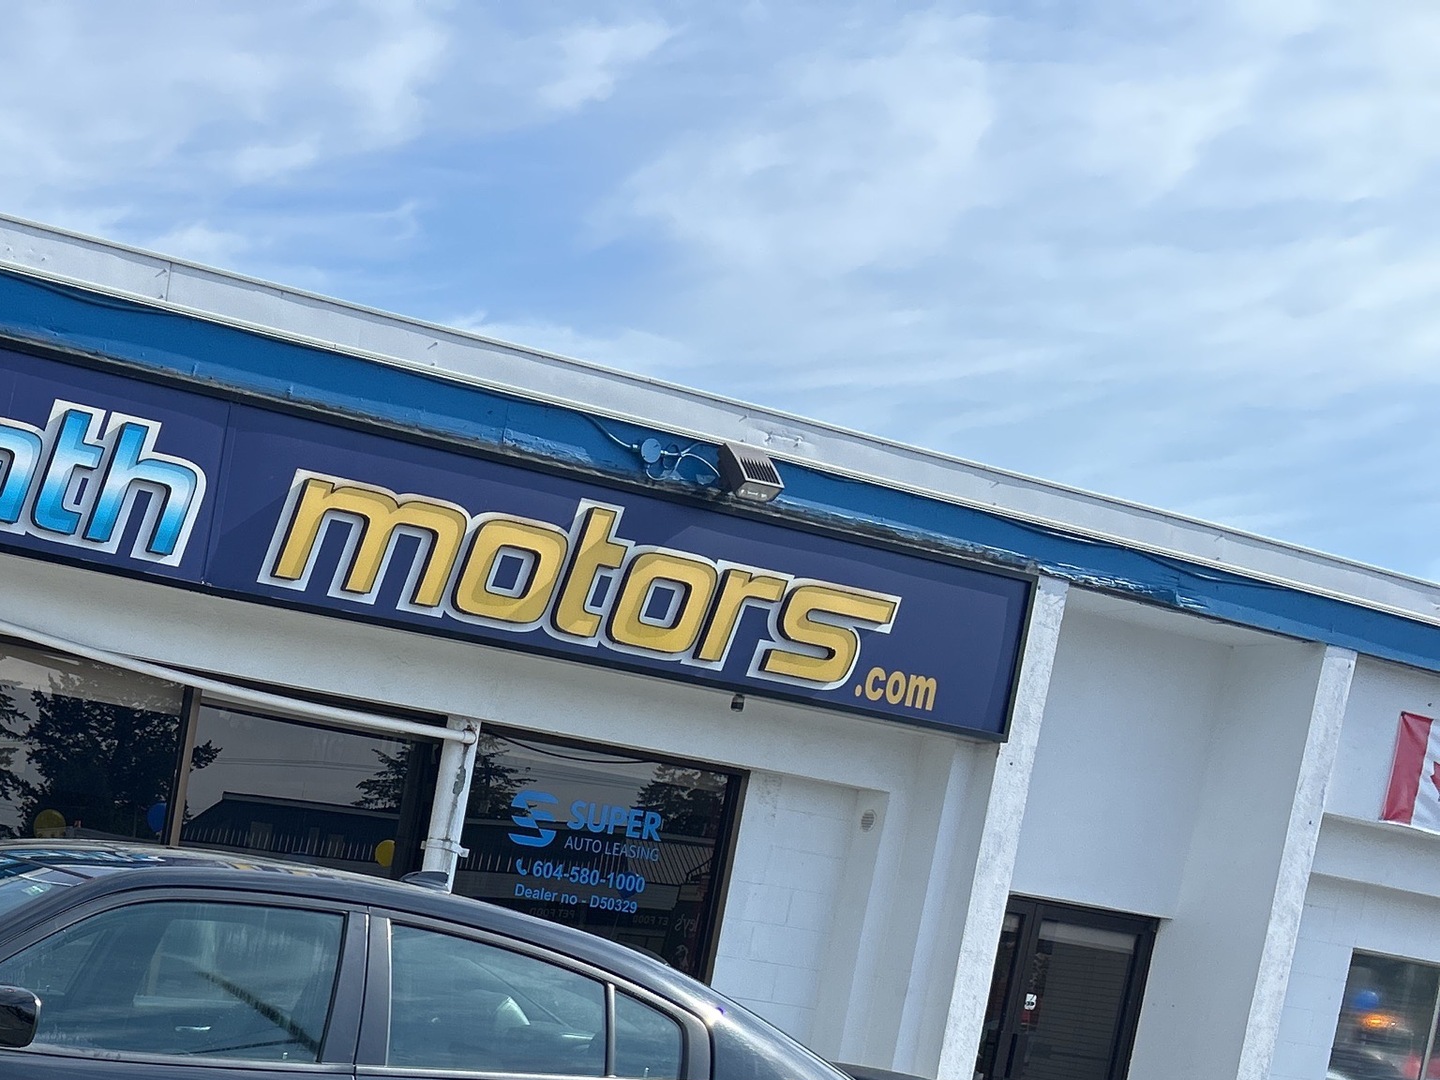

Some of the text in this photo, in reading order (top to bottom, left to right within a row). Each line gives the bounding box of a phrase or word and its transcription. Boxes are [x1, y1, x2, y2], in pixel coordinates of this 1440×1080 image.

[257, 468, 902, 690] motors
[566, 800, 662, 842] SUPER
[564, 836, 660, 862] AUTO LEASING
[532, 860, 646, 894] 604-580-1000
[515, 884, 558, 905] Dealer
[561, 892, 578, 906] no
[589, 895, 638, 914] D50329
